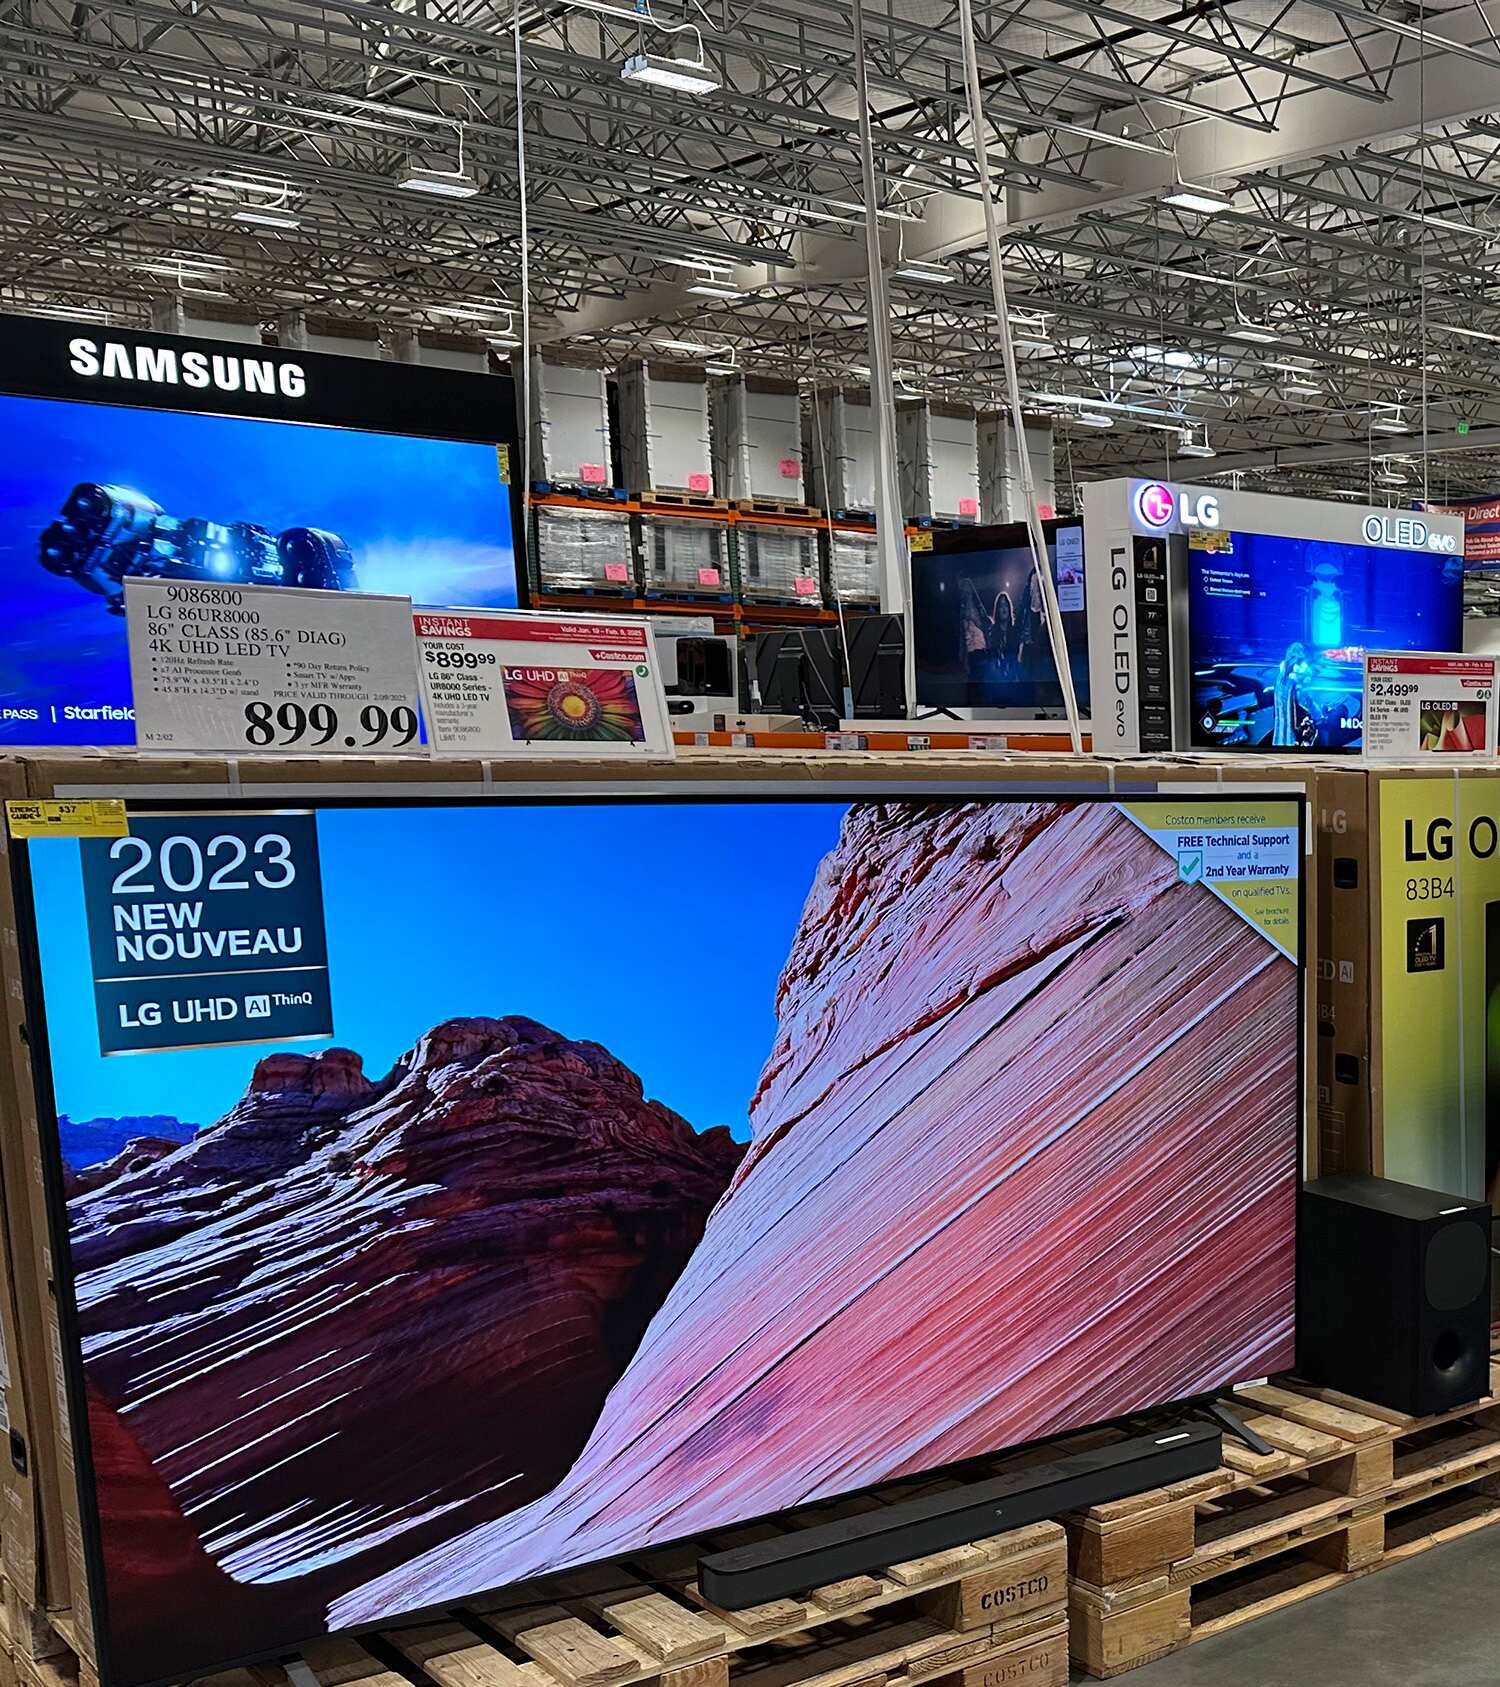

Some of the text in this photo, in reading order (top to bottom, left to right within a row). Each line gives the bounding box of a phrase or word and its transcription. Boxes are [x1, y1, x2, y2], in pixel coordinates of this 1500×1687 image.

[68, 338, 306, 398] SAMSUNG
[1180, 493, 1219, 527] LG
[1468, 506, 1500, 521] Direct
[1362, 515, 1457, 552] OLED evo
[1111, 547, 1127, 591] LG
[167, 586, 242, 605] 9086800
[147, 605, 260, 625] LG 86UR8000
[419, 616, 469, 627] INSTANT
[148, 622, 347, 646] 86" CLASS (85.6" DIAG)
[420, 625, 472, 637] SAVINGS
[560, 625, 577, 633] Valid
[149, 638, 291, 658] 4K UHD LED TV
[422, 641, 444, 650] YOUR
[308, 662, 369, 673] Day Return Policy
[428, 672, 439, 680] LG
[504, 669, 554, 681] LG UHD
[1113, 604, 1130, 737] OLED evo
[1370, 664, 1399, 673] SAVINGS
[273, 690, 369, 700] PRICE VALID THROUGH
[462, 683, 487, 692] Series
[432, 693, 490, 702] 4K UHD LED TV
[1421, 702, 1451, 711] LG OLED
[244, 701, 418, 748] 899.99
[59, 805, 76, 813] $37
[1165, 814, 1266, 826] Costco members receive
[1322, 808, 1346, 834] LG
[1177, 834, 1290, 848] FREE Technical Support
[1404, 817, 1454, 862] LG
[109, 833, 296, 894] 2023
[1237, 851, 1250, 860] and
[1205, 864, 1290, 878] 2nd Year Warranty
[1231, 889, 1242, 898] on
[1243, 886, 1274, 899] qualified
[1406, 876, 1455, 901] 83B4
[113, 901, 203, 932] NEW
[116, 927, 302, 962] NOUVEAU
[119, 1001, 162, 1028] LG
[172, 997, 238, 1023] UHD
[272, 991, 313, 1007] ThinQ
[981, 1575, 1049, 1610] COSTCO
[983, 1652, 1049, 1687] COSTCO
